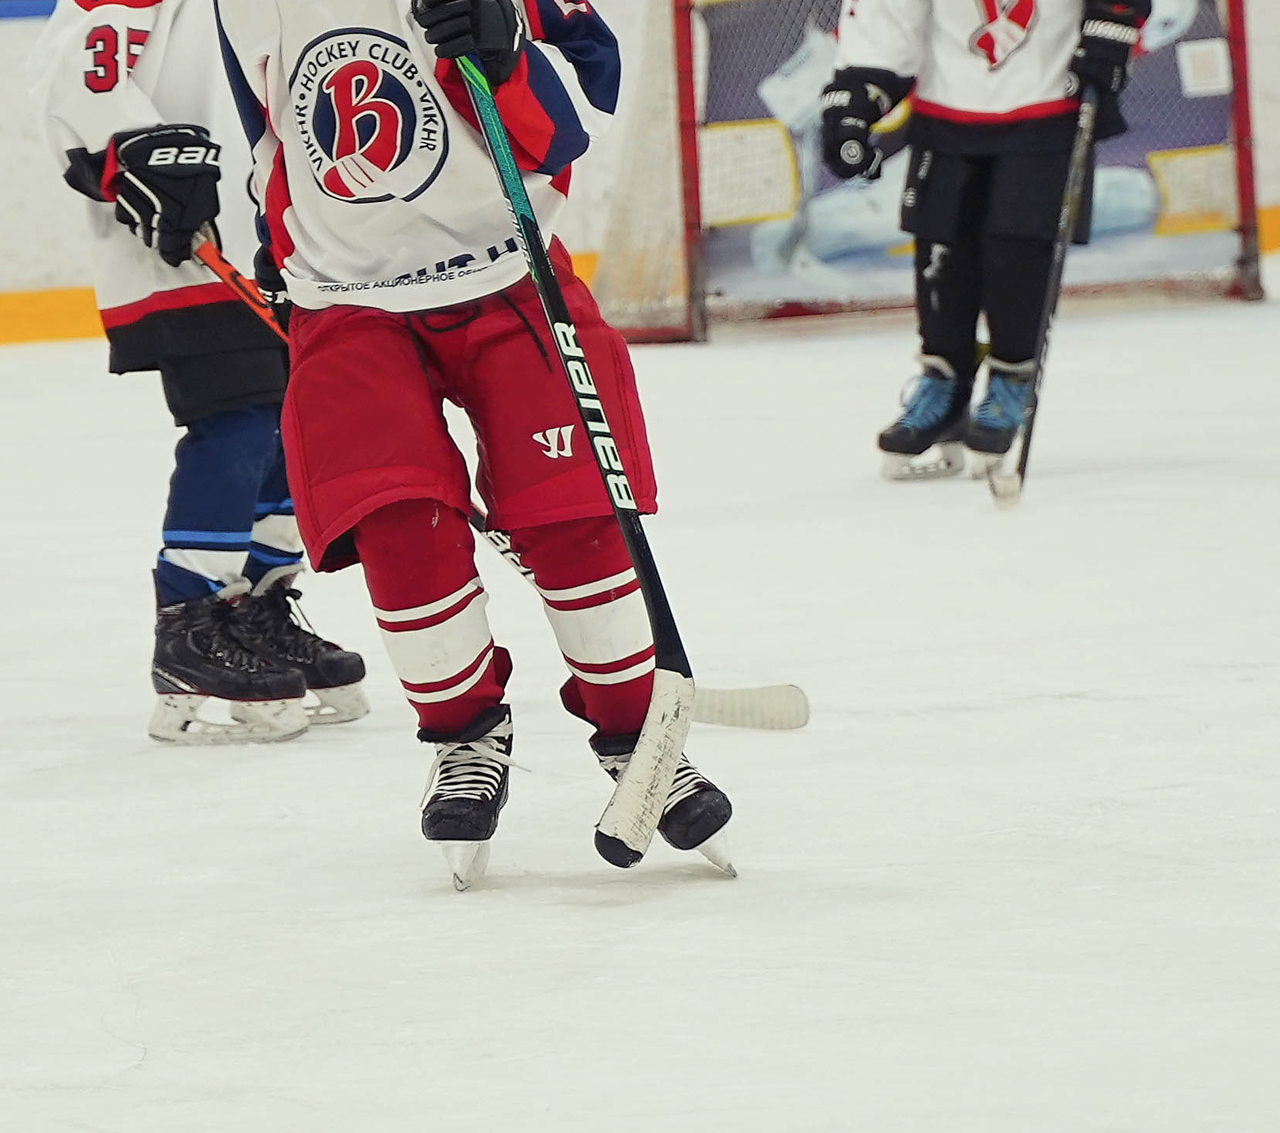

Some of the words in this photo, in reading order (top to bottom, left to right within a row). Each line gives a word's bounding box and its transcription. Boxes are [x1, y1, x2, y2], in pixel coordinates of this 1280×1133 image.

[300, 40, 360, 92] HOCKEY
[369, 43, 418, 81] CLUB
[419, 91, 440, 152] VIKHR
[552, 321, 637, 511] BAUER
